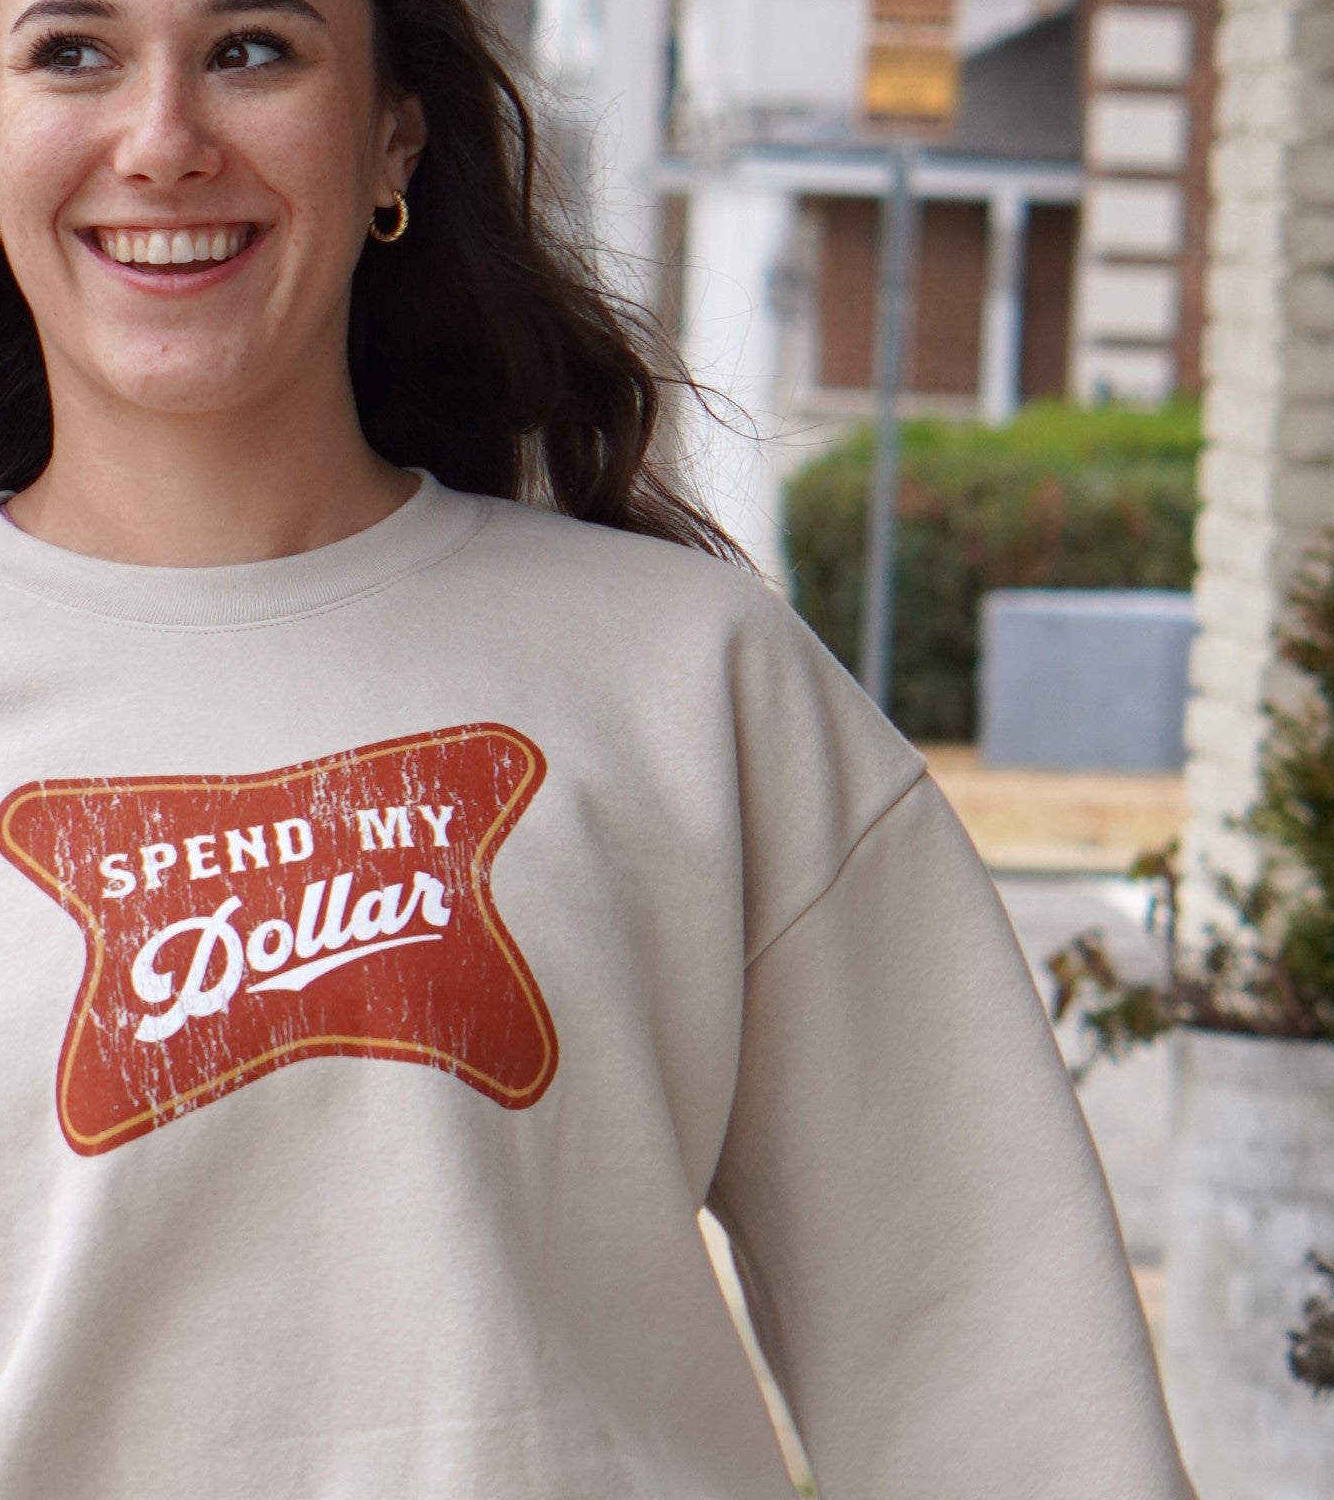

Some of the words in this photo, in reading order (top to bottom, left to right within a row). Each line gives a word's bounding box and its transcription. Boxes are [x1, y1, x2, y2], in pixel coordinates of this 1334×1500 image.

[99, 816, 315, 902] SPEND
[356, 804, 455, 852] MY
[130, 870, 452, 1044] Dollar
